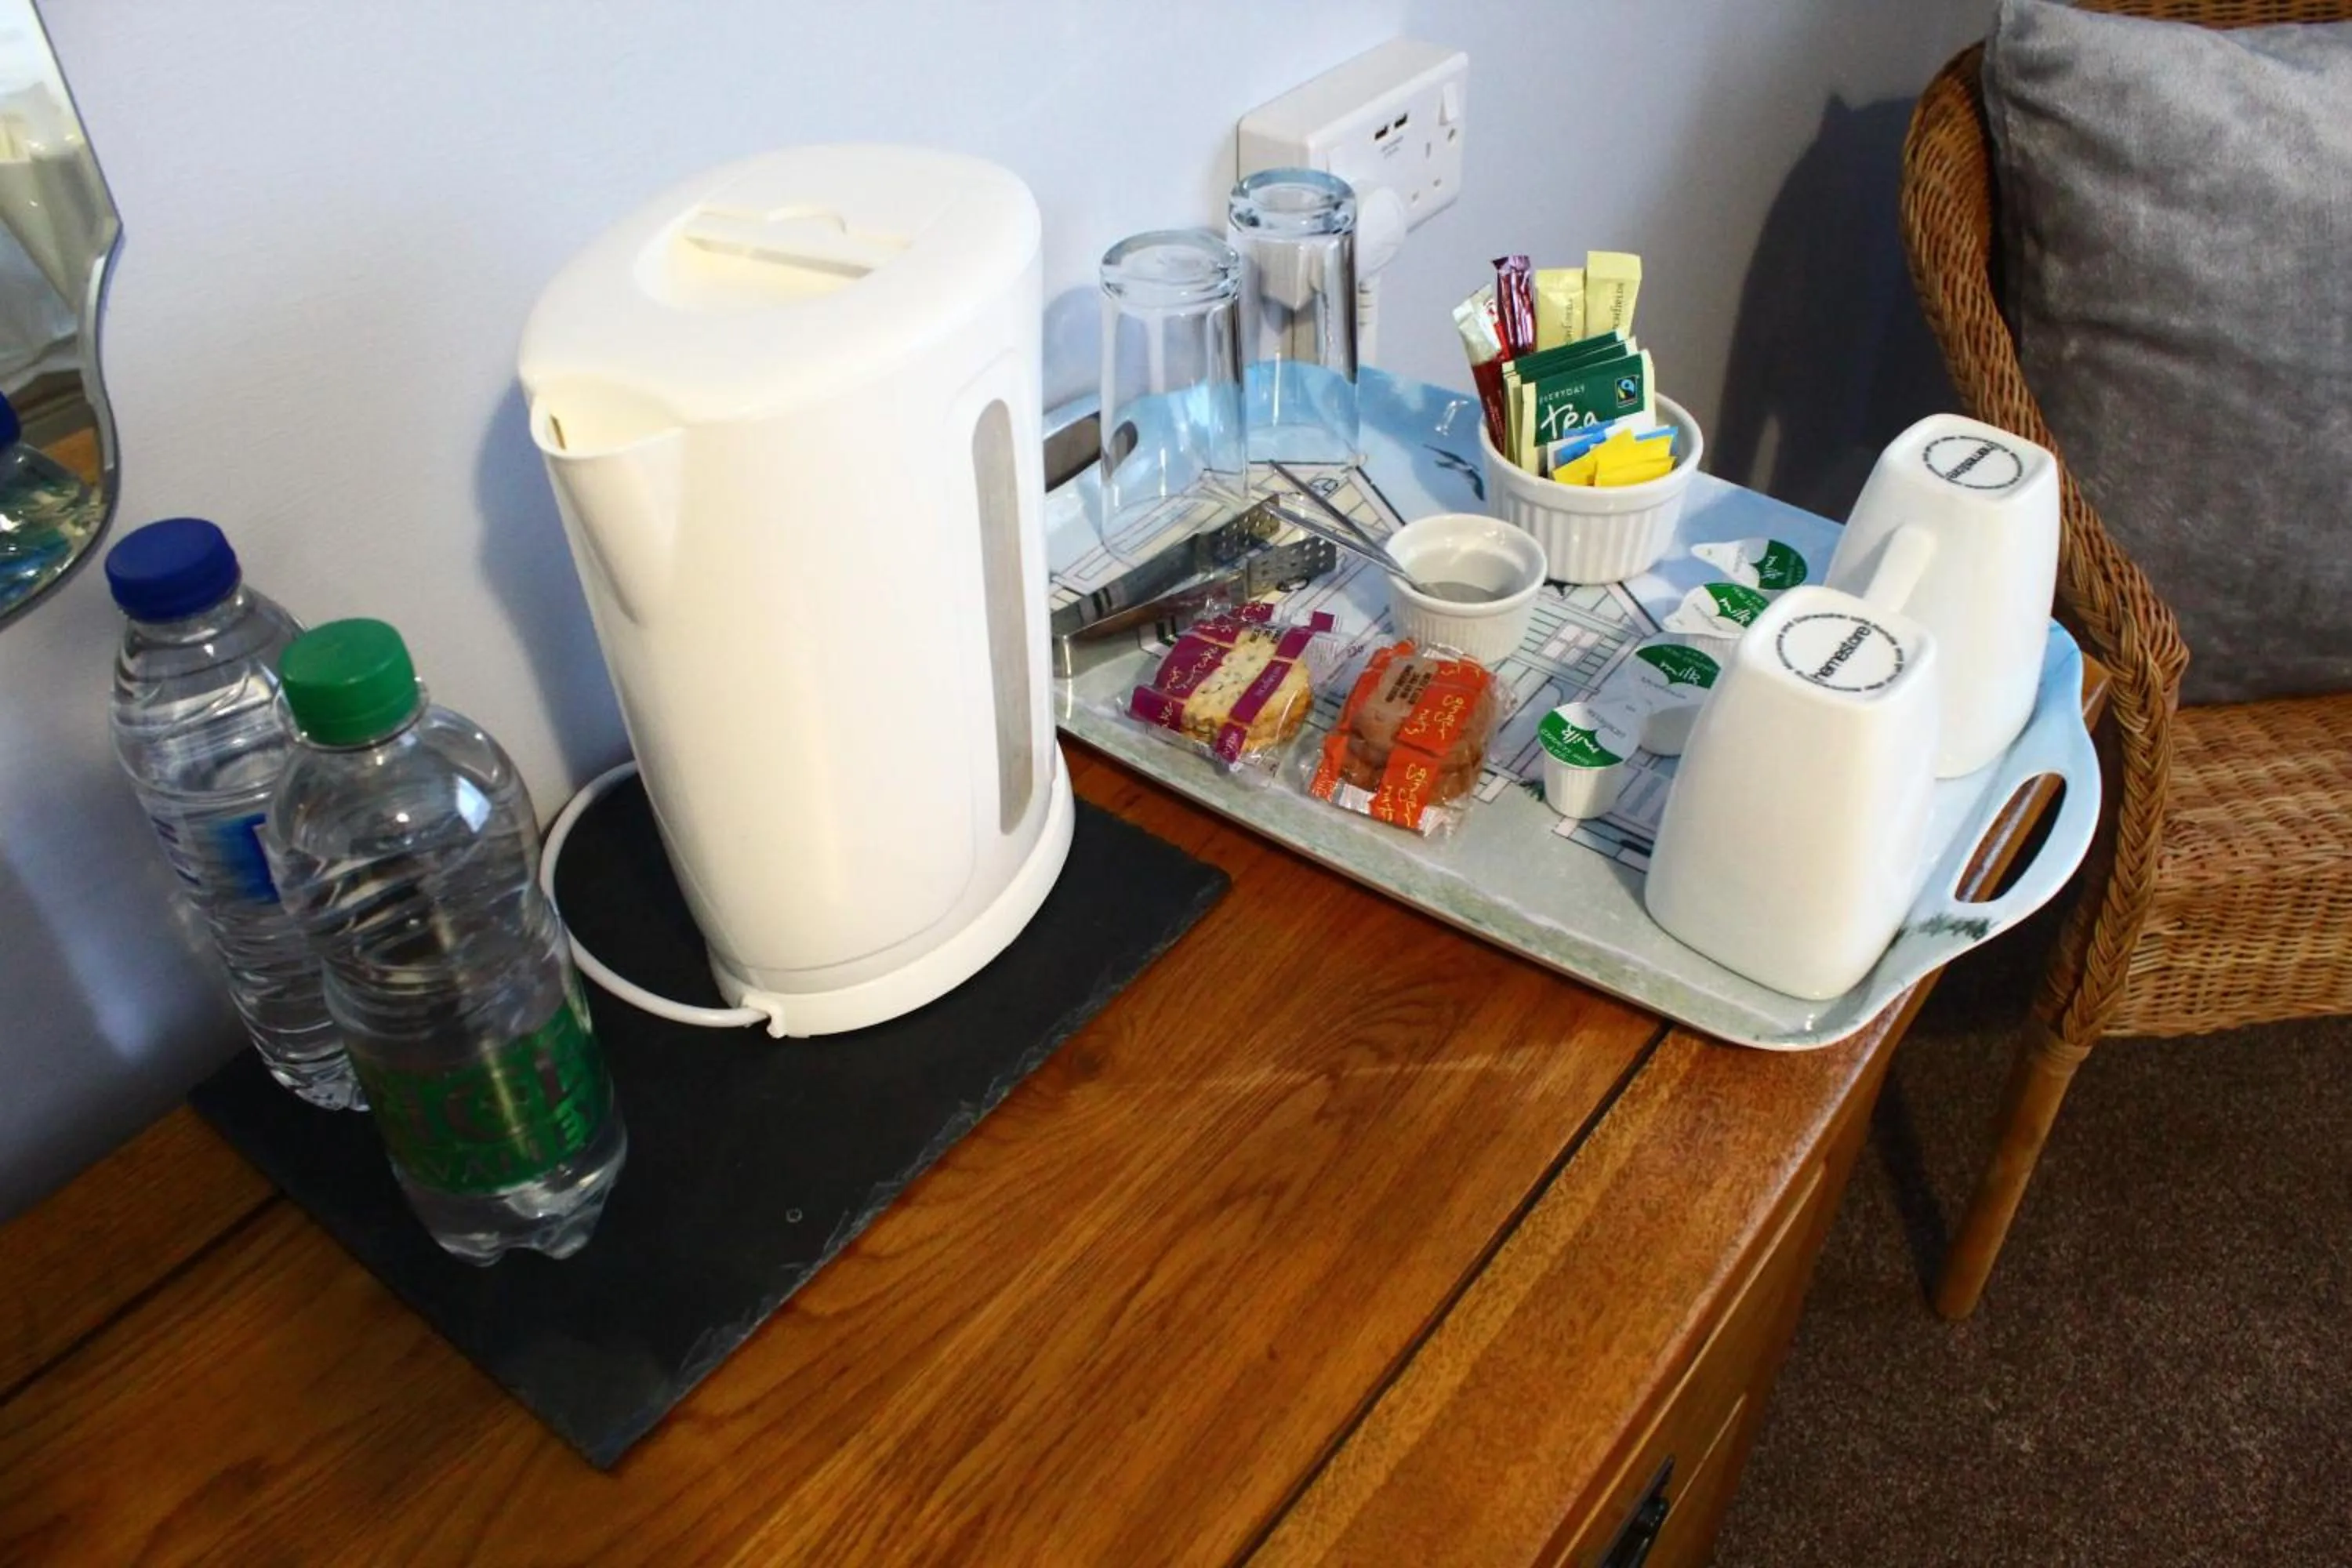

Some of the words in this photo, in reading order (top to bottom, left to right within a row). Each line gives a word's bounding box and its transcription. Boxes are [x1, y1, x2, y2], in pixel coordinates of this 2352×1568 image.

[1719, 597, 1750, 627] milk
[1660, 661, 1700, 684] milk
[1809, 626, 1871, 682] homestore
[1433, 695, 1465, 739] ginger
[1562, 722, 1599, 754] milk
[1397, 762, 1426, 827] ginger
